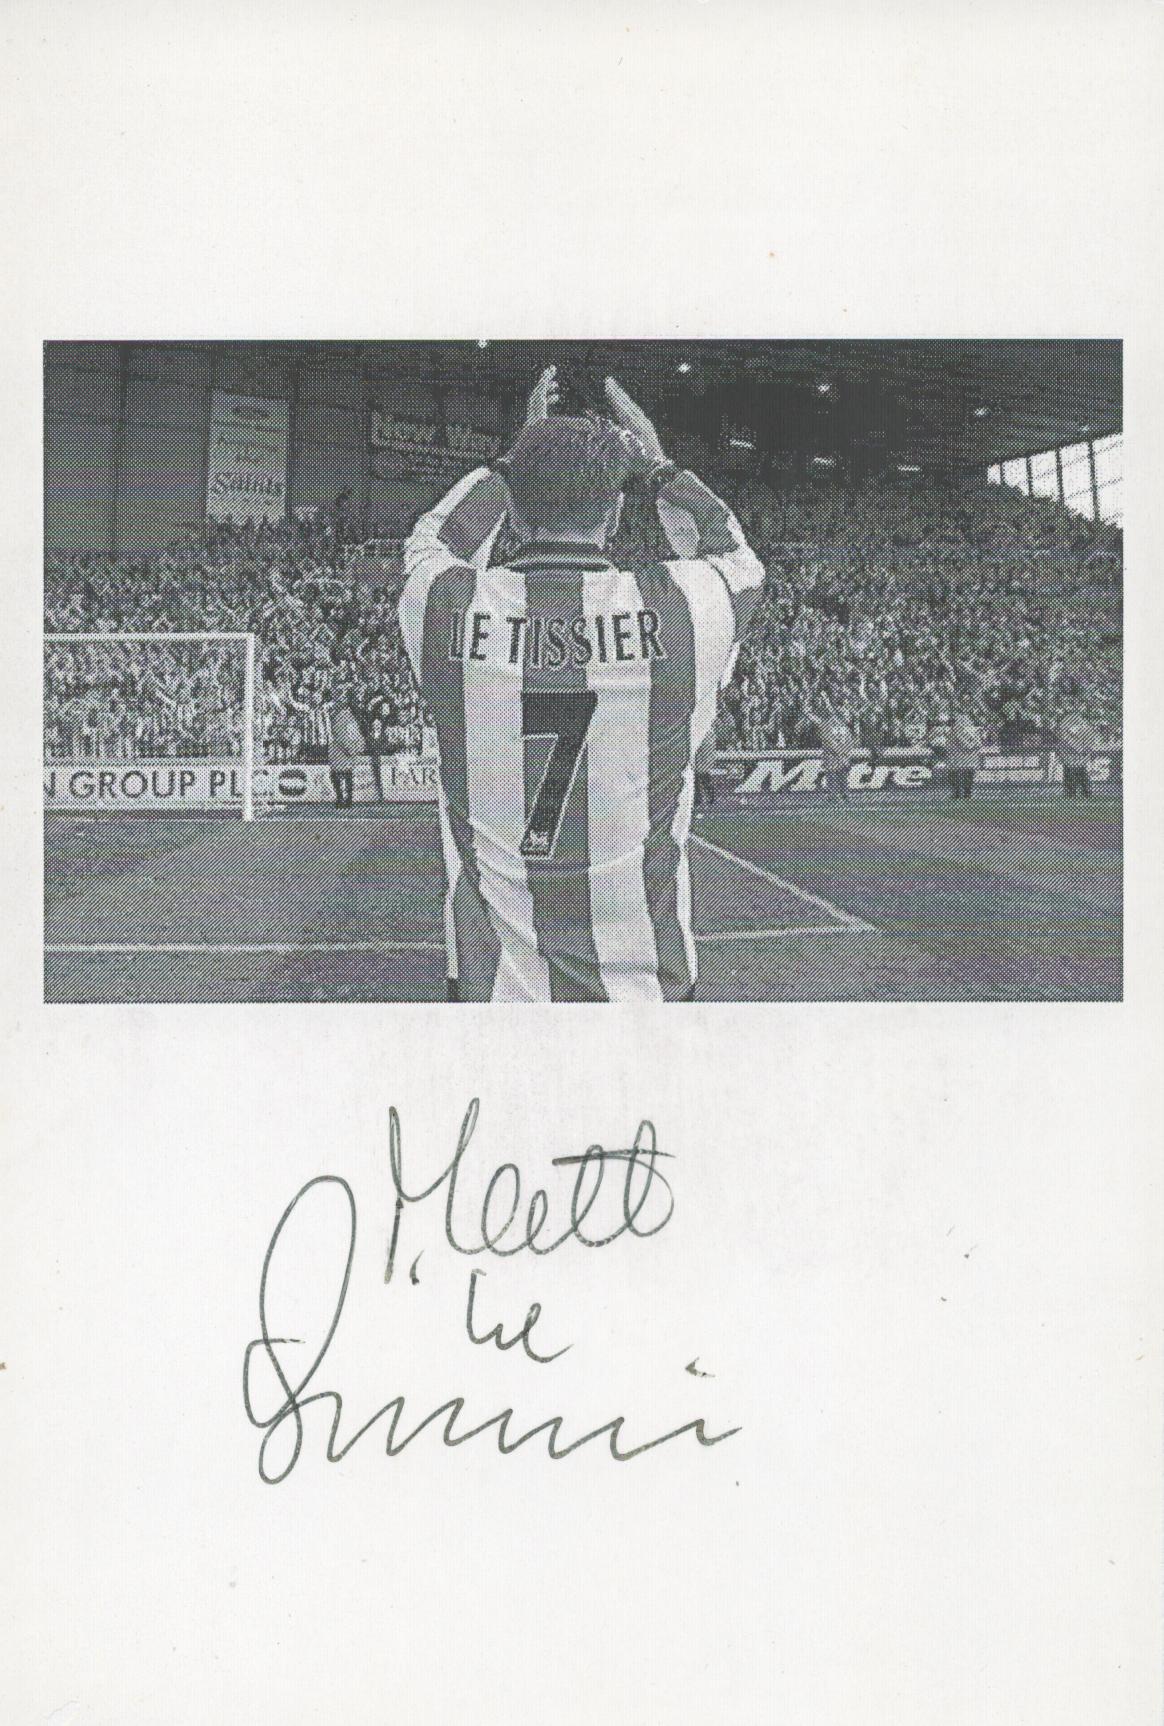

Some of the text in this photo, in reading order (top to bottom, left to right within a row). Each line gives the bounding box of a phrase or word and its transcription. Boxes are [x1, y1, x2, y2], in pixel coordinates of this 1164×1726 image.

[210, 472, 285, 497] Saints
[449, 607, 667, 669] LE TISSIER
[69, 769, 197, 799] GROUP
[520, 690, 599, 861] 7
[734, 759, 933, 794] Mtre
